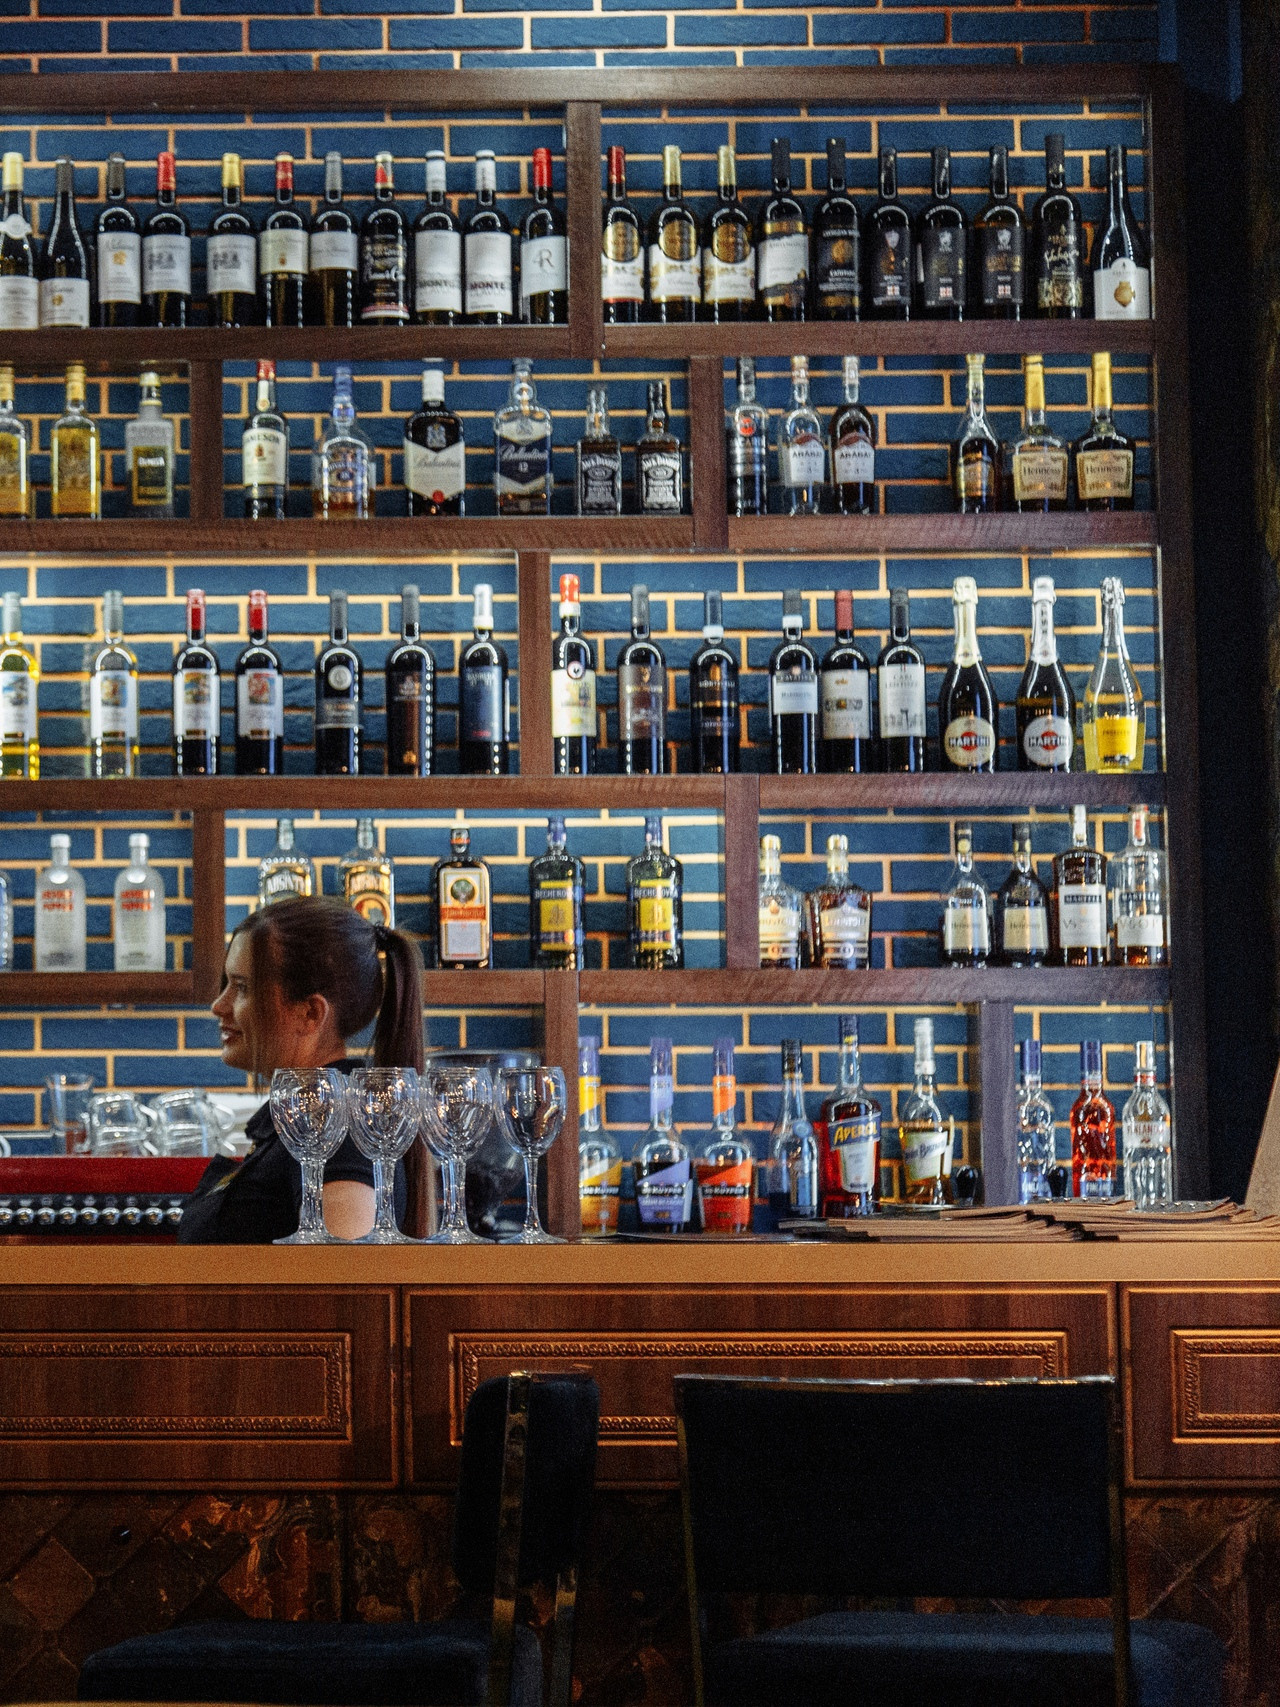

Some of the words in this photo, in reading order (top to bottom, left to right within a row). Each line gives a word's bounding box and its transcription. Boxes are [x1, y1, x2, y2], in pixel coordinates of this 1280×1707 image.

[949, 736, 991, 747] MARTINI
[1028, 736, 1070, 748] MARTINI
[634, 887, 679, 899] BECHEOVKA
[833, 1121, 878, 1146] APEROL
